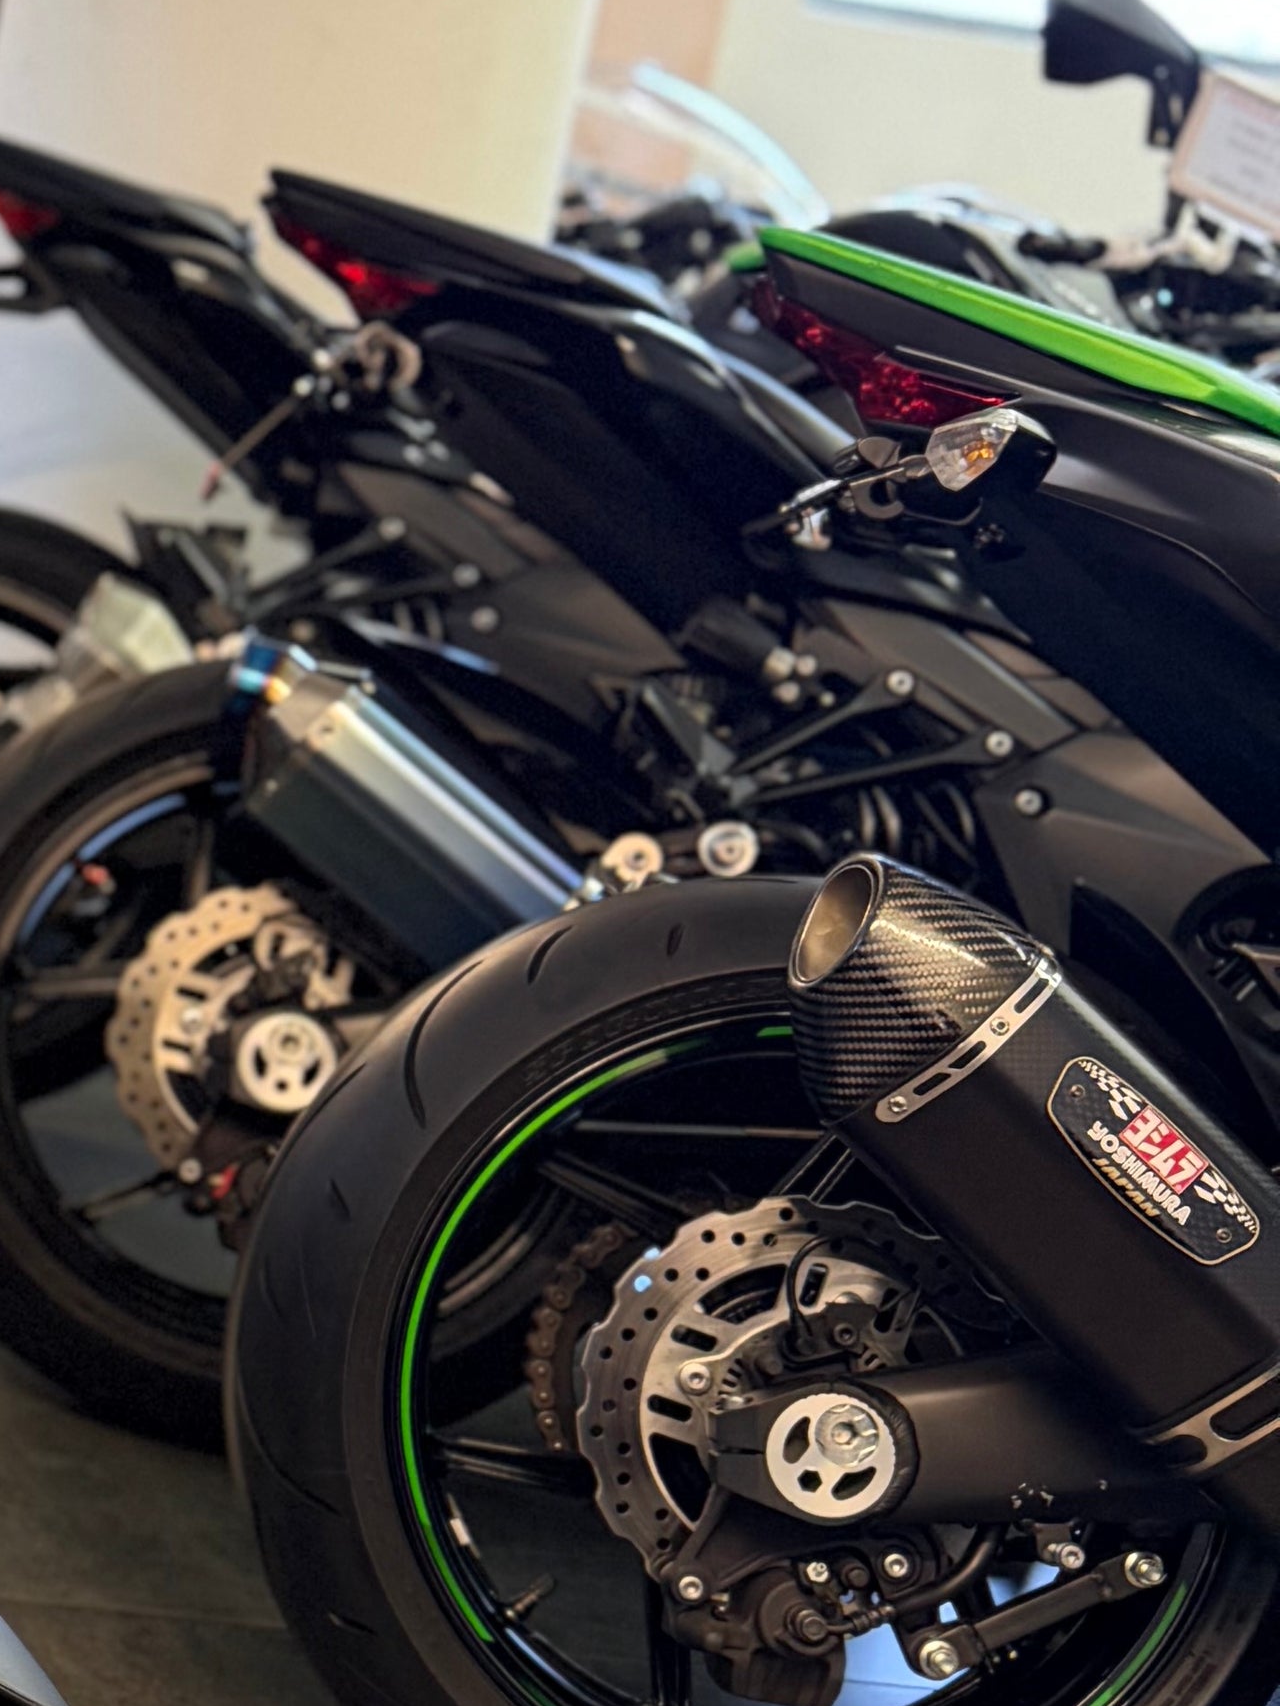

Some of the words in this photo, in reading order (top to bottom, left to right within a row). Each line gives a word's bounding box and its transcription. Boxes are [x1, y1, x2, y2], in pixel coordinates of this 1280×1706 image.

[1087, 1120, 1191, 1226] YOSHIMURA
[1092, 1157, 1160, 1217] JAPAN
[1121, 1109, 1204, 1188] ヨシムラ
